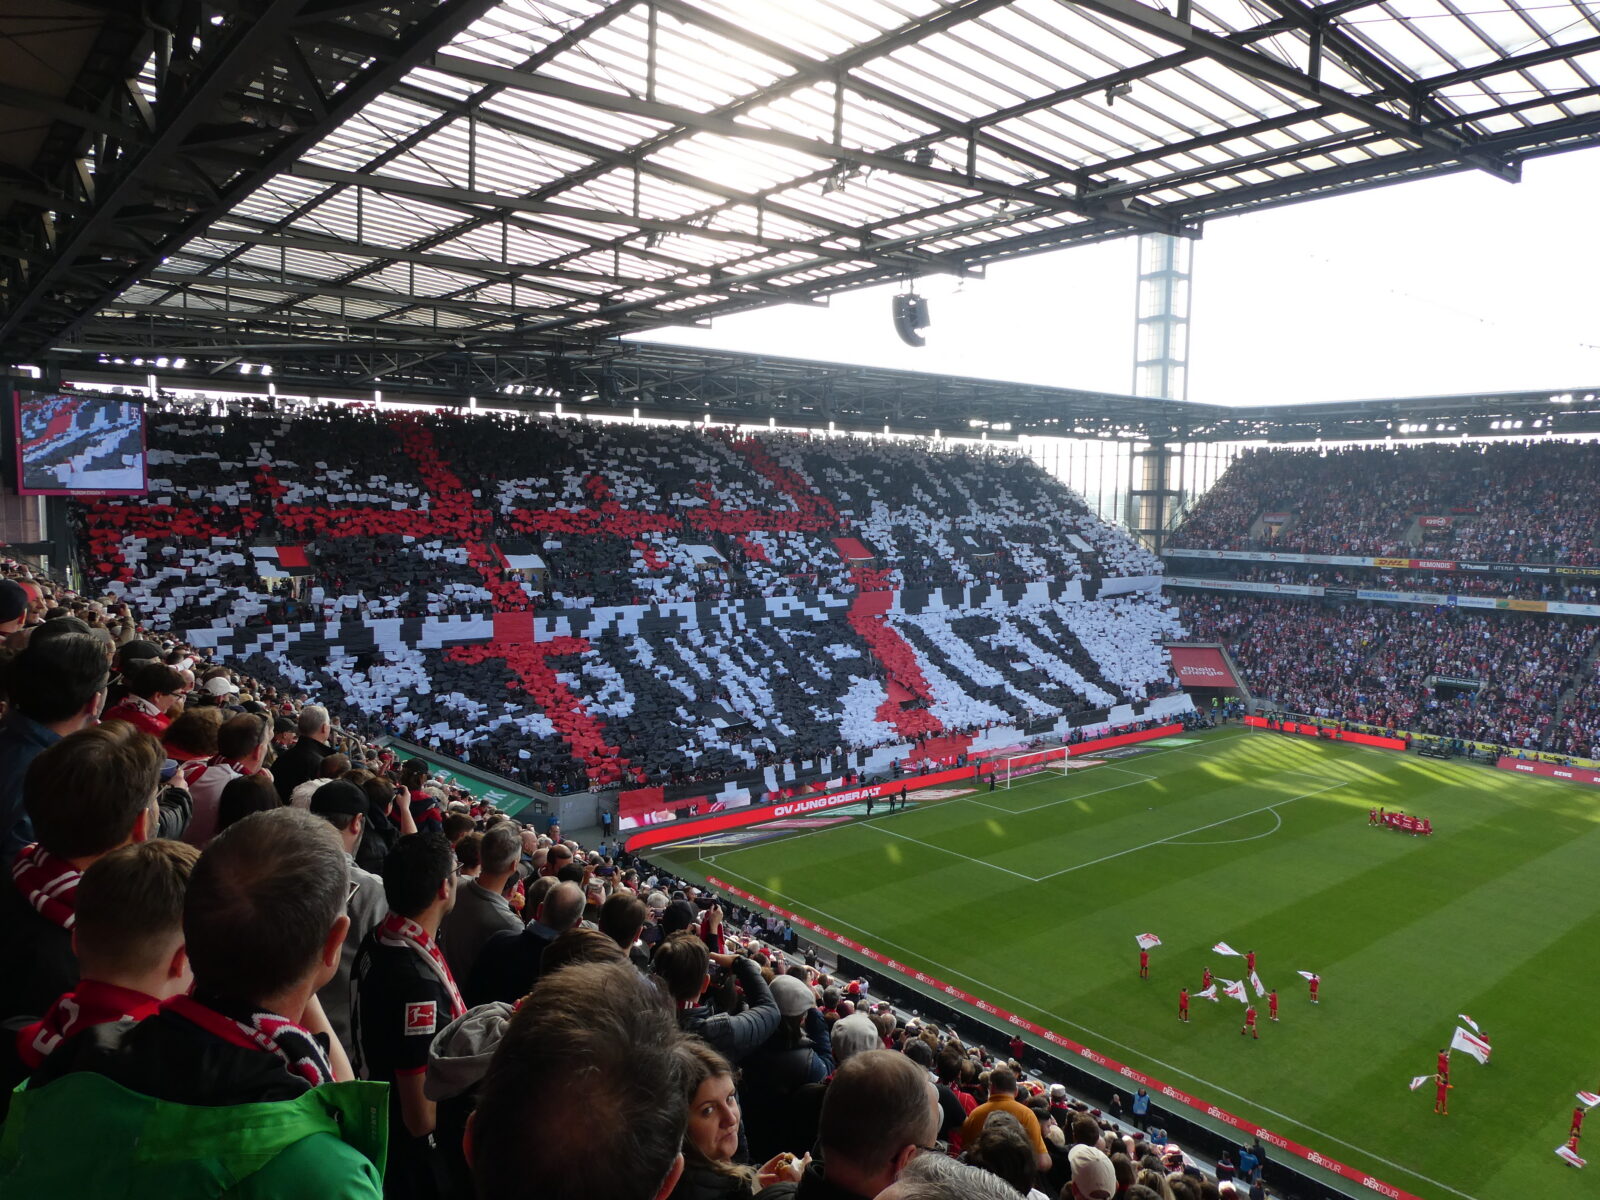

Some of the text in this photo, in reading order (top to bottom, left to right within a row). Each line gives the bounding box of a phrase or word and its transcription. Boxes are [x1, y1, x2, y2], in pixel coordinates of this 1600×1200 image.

[774, 787, 881, 816] OV JUNG ODER ALT
[945, 986, 965, 999] DERTOUR
[976, 1000, 997, 1015] DERTOUR
[1009, 1015, 1031, 1030] DERTOUR
[1044, 1030, 1068, 1047] DERTOUR
[1081, 1048, 1106, 1065] DERTOUR
[1120, 1067, 1147, 1084] DERTOUR
[1163, 1086, 1191, 1105] DERTOUR
[1208, 1106, 1237, 1126] DERTOUR
[1256, 1128, 1288, 1149] DERTOUR
[1307, 1151, 1341, 1173] DERTOUR
[1363, 1177, 1399, 1199] DERTOUR
